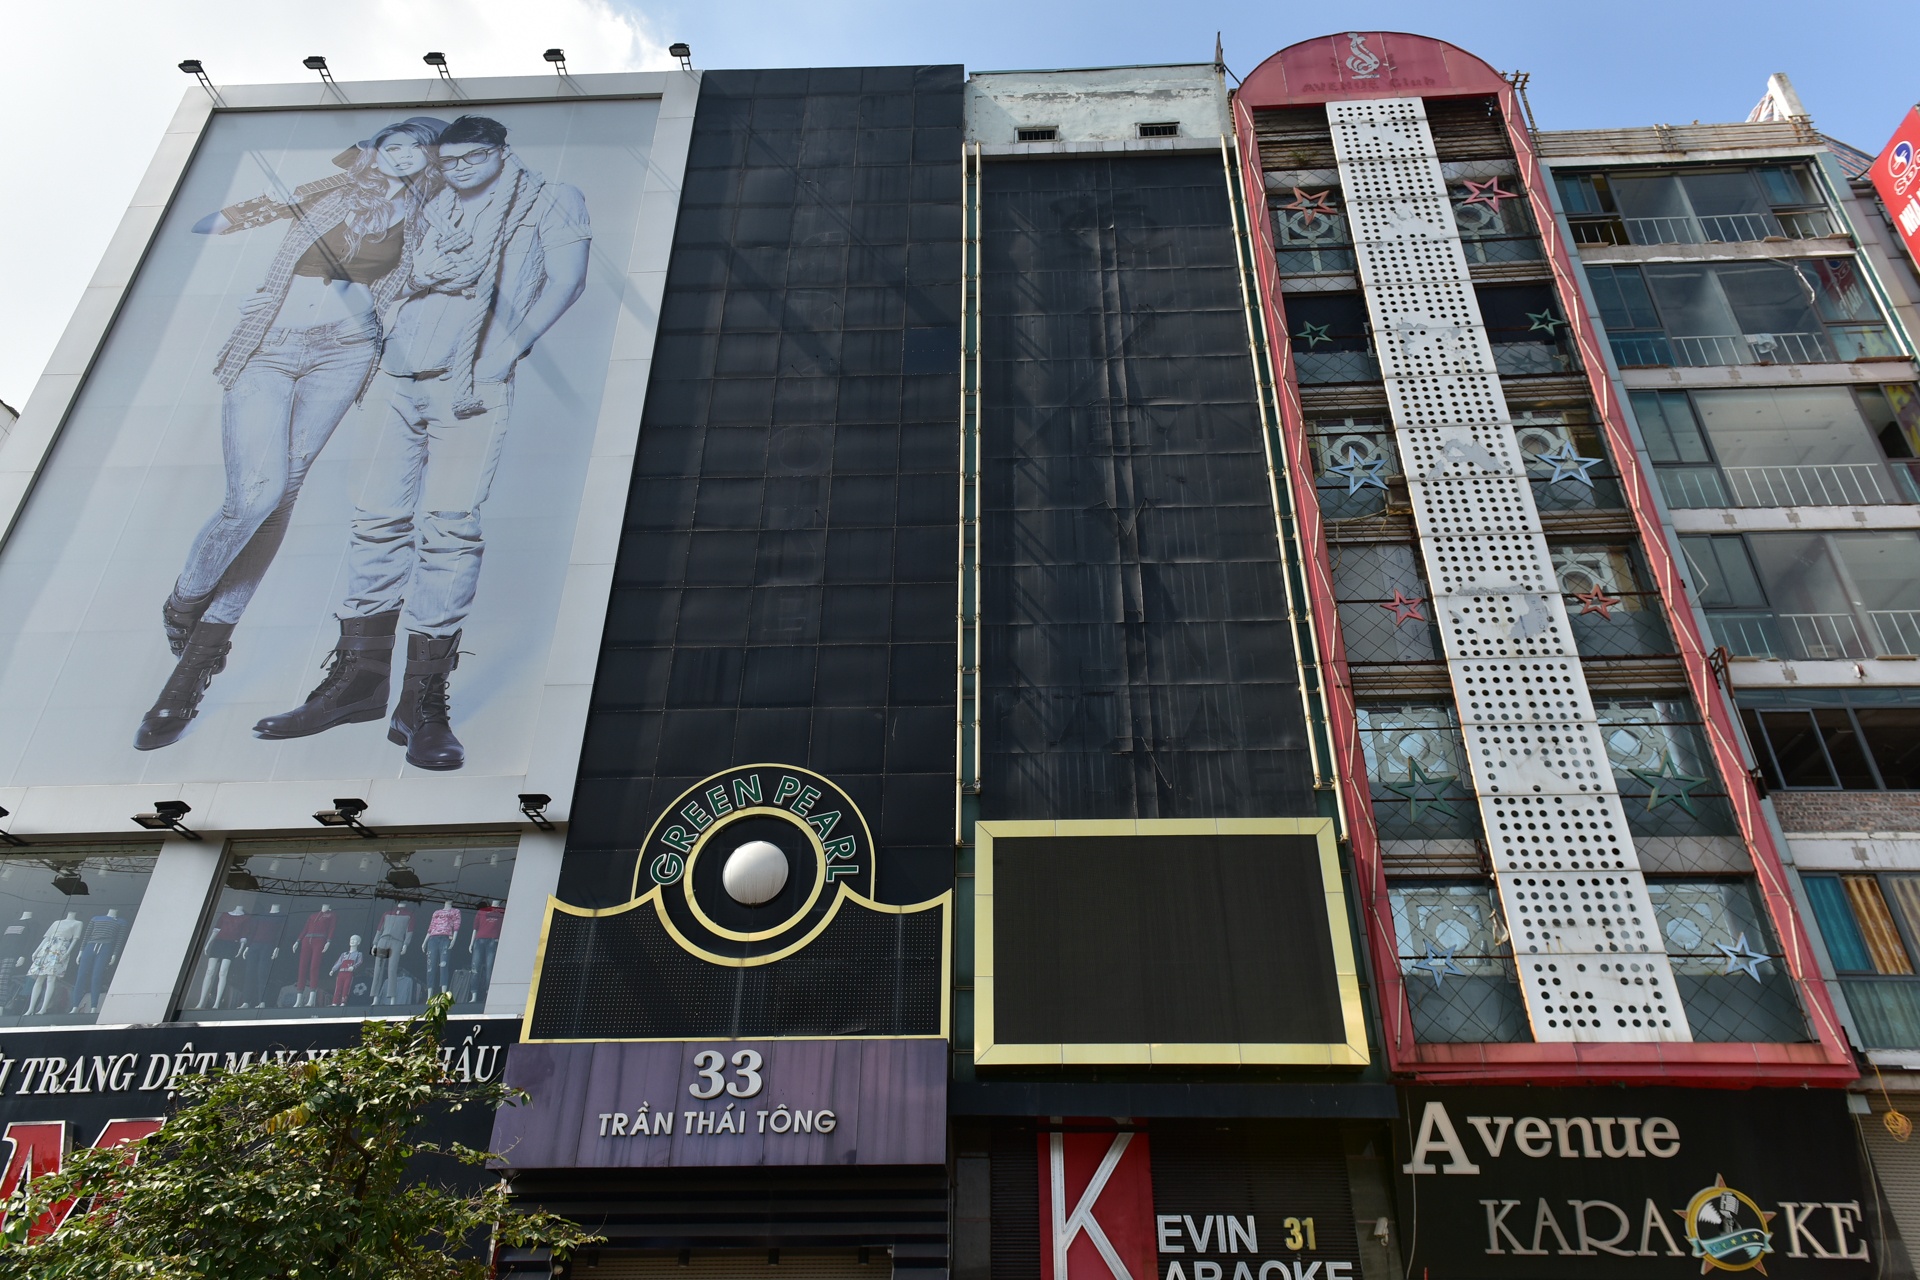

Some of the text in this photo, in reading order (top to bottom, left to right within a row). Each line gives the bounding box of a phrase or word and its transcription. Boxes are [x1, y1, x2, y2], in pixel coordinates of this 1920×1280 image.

[650, 774, 860, 885] GREEN PEARL
[15, 1052, 140, 1096] TRANG
[433, 1024, 502, 1083] HẨU
[688, 1049, 765, 1100] 33
[598, 1101, 838, 1136] TRẦN THÁI TÔNG
[1402, 1101, 1681, 1175] Avenue
[1156, 1214, 1317, 1254] EVIN 31
